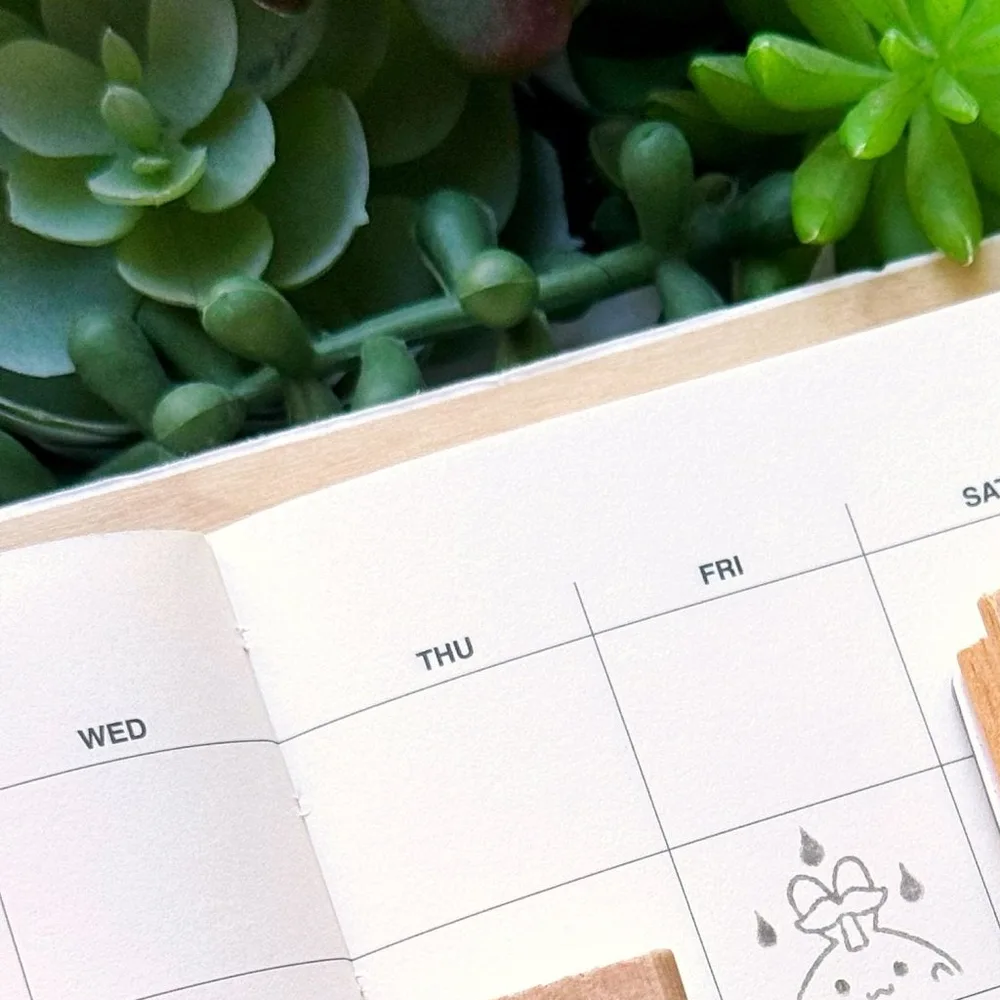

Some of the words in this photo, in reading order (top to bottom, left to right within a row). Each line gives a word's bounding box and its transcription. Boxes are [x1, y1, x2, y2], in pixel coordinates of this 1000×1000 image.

[698, 554, 744, 585] FRI
[415, 636, 475, 672] THU
[77, 718, 147, 750] WED
